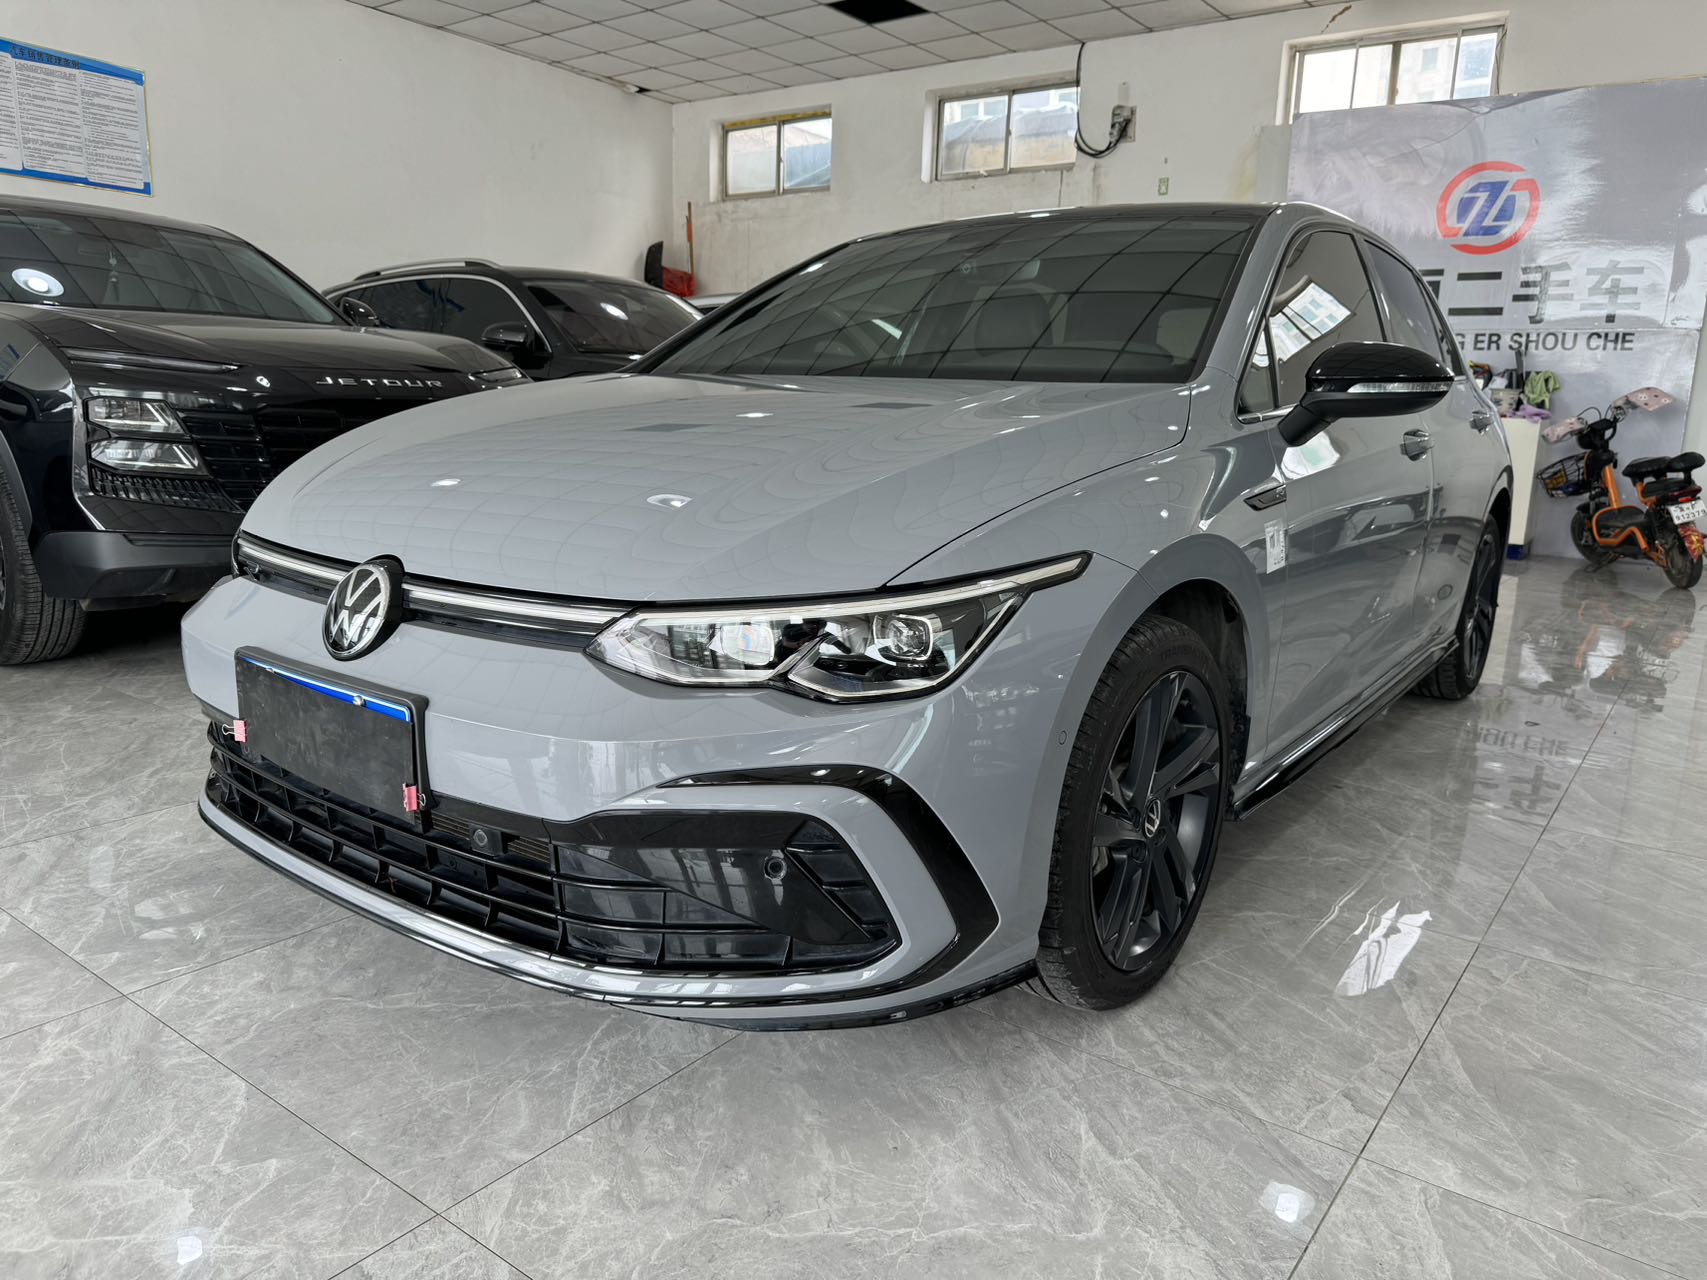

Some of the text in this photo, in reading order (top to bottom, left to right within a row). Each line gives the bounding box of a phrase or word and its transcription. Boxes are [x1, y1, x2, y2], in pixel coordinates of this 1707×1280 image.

[1473, 333, 1502, 351] ER
[1508, 332, 1578, 351] SHOU
[1586, 332, 1635, 351] CHE
[316, 376, 443, 388] JETOUR
